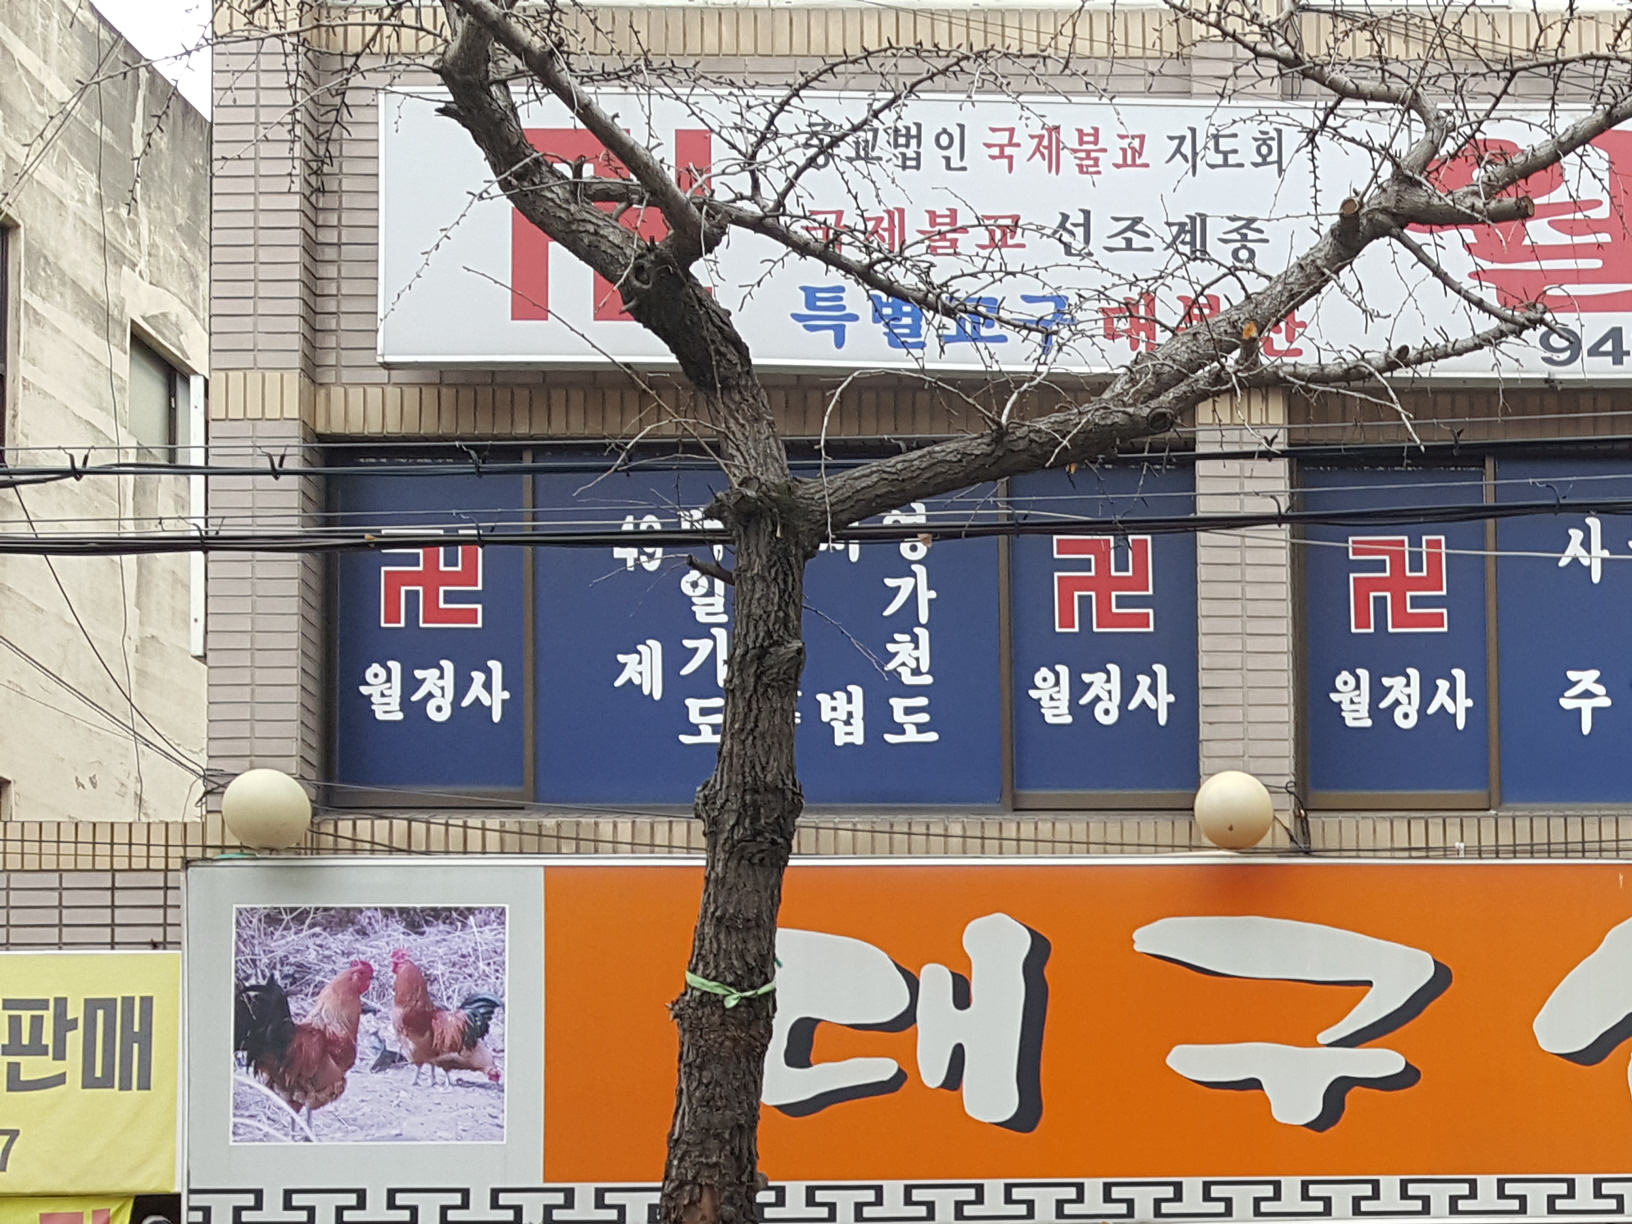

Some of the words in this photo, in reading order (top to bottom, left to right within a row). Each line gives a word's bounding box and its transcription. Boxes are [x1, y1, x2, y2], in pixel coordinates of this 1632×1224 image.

[982, 124, 1150, 176] 국제불교
[801, 208, 1027, 257] 국제불교
[1052, 209, 1270, 264] 선조계종
[791, 285, 1075, 355] 특별교구
[359, 658, 511, 724] 월정사
[1028, 663, 1176, 727] 월정사
[1329, 667, 1474, 731] 월정사
[1, 995, 154, 1092] 판매
